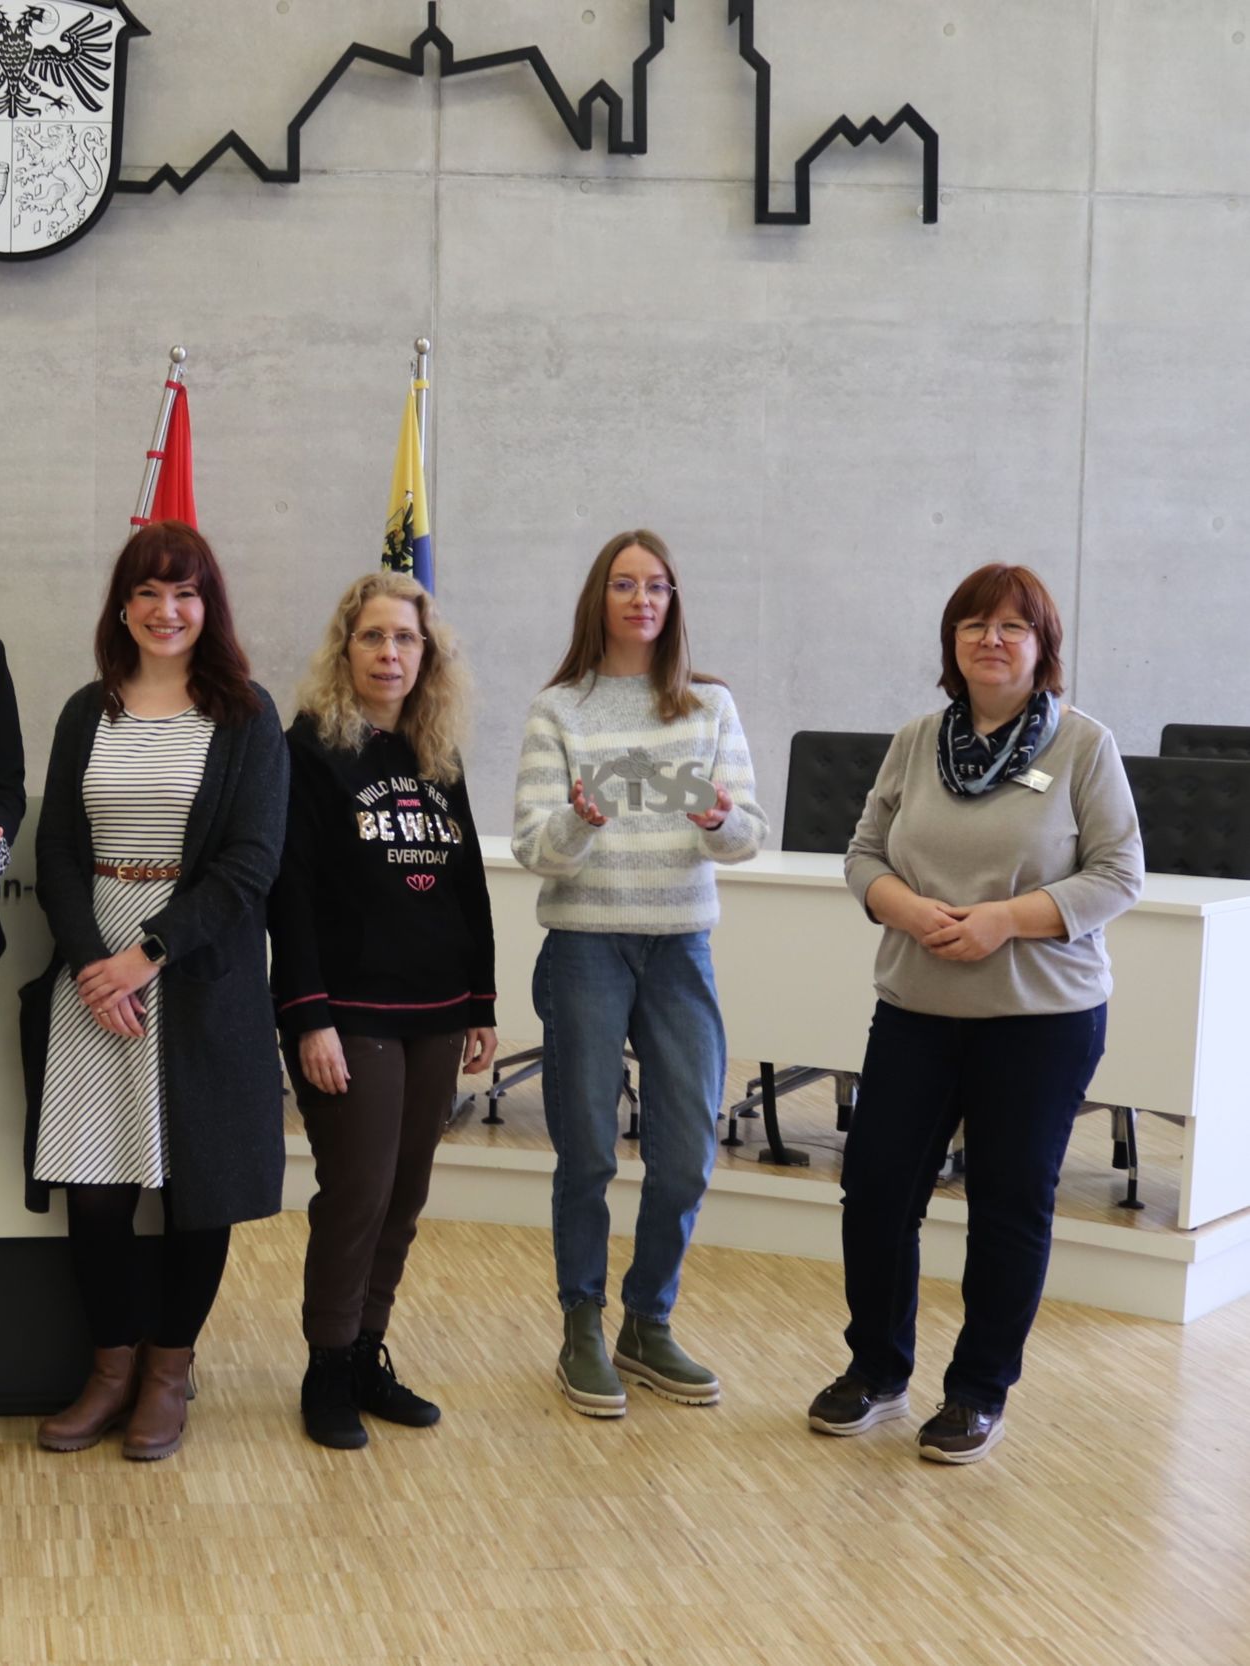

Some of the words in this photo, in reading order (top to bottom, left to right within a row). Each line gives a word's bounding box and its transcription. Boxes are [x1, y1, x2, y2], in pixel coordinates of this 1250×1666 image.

[355, 780, 390, 807] WILD
[390, 776, 418, 793] AND
[356, 811, 395, 841] BE
[397, 812, 462, 845] WILD
[387, 848, 449, 865] EVERYDAY
